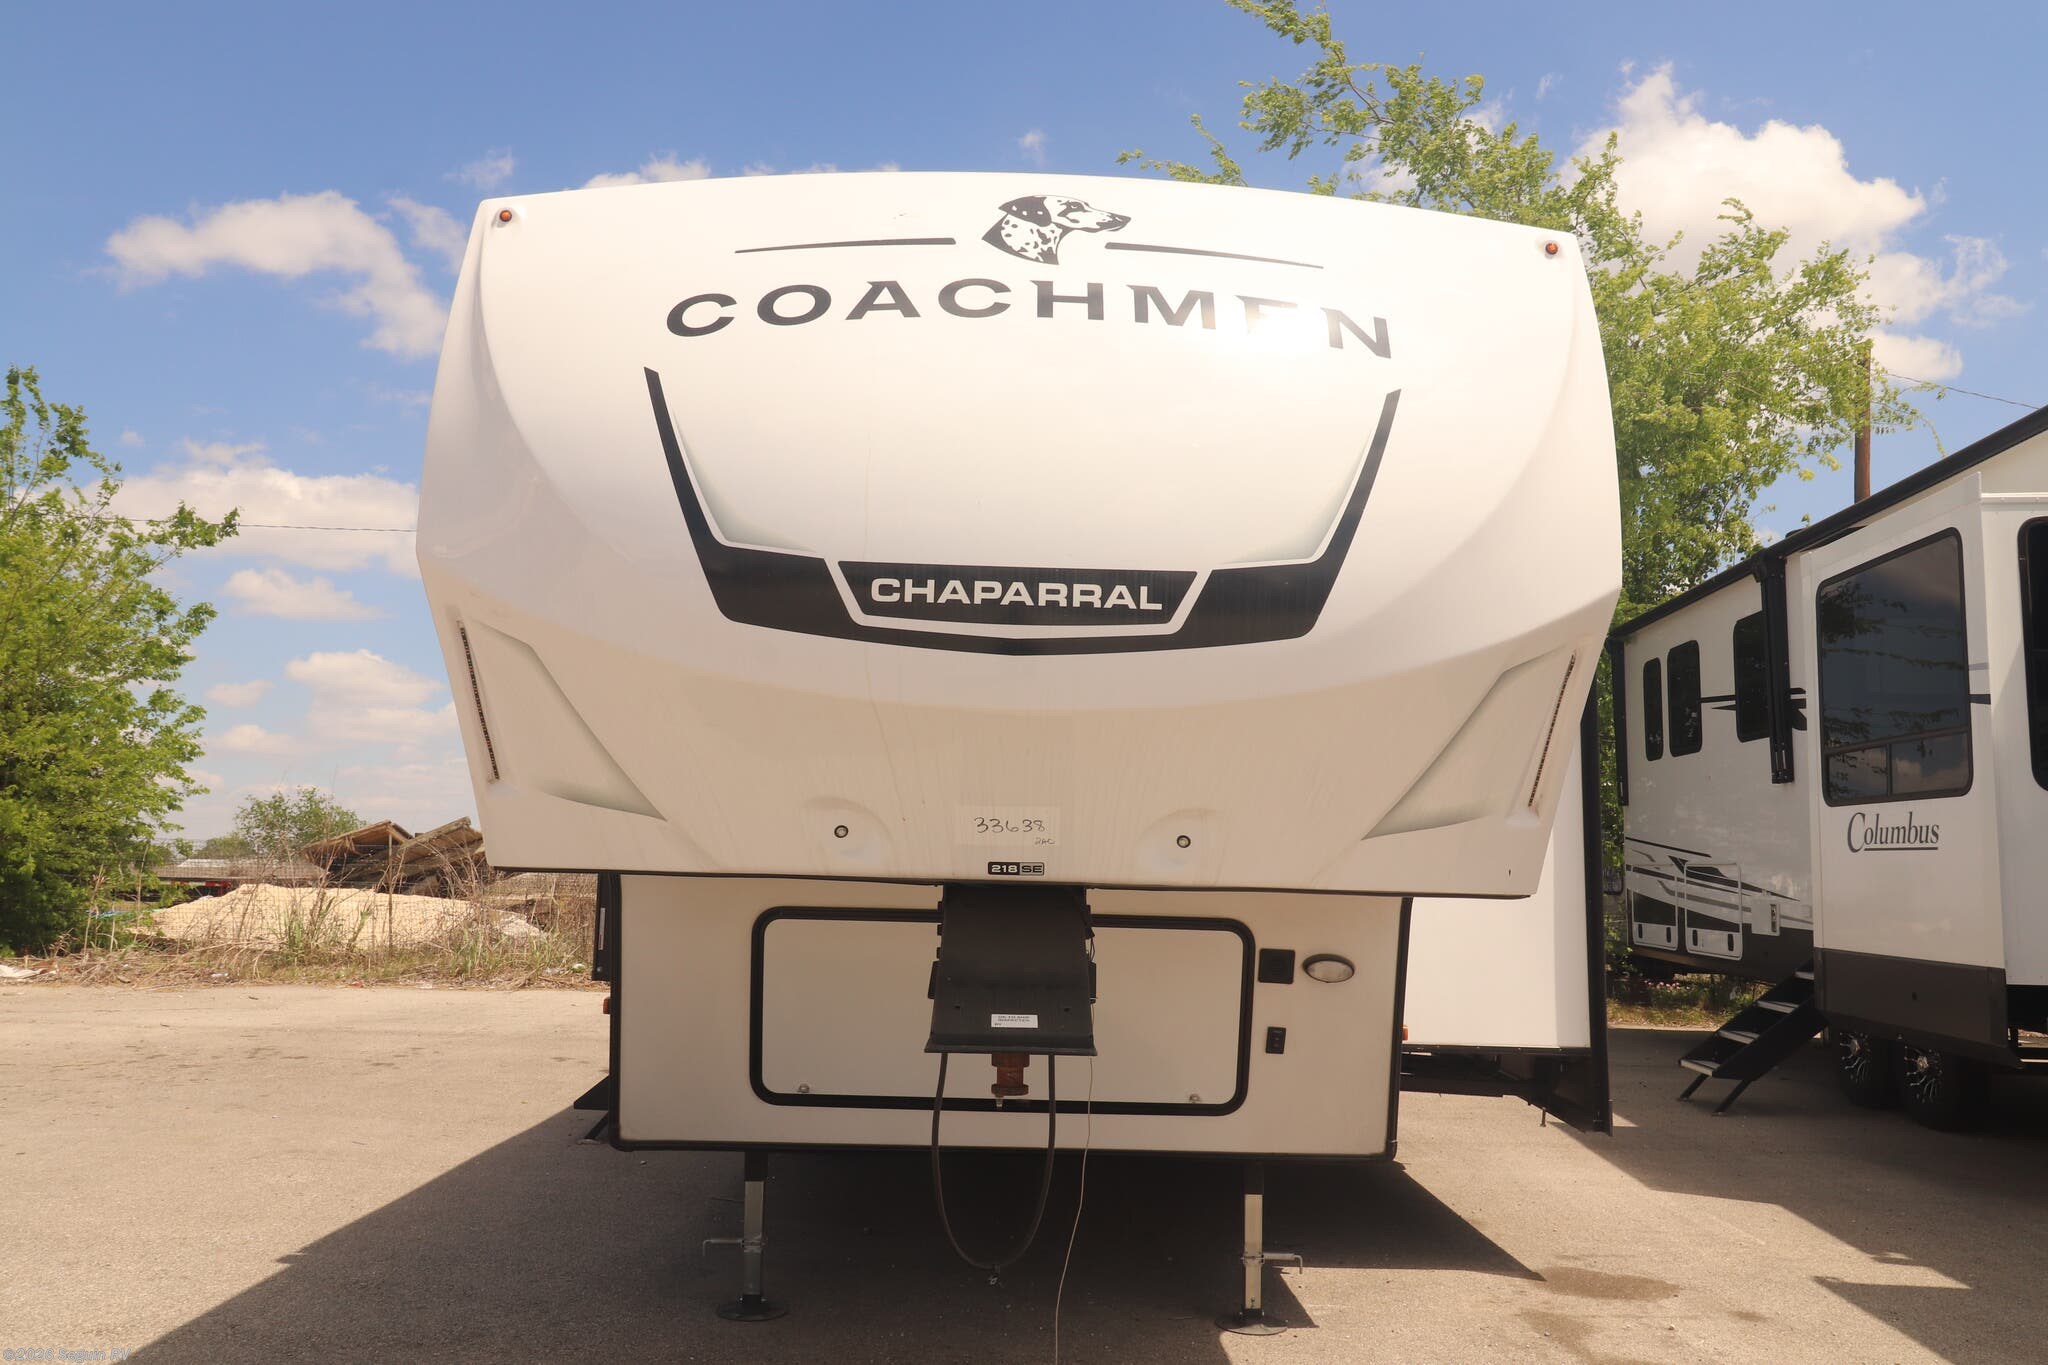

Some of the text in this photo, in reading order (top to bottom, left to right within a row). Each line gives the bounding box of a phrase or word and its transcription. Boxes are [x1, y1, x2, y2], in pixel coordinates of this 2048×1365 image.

[870, 577, 1163, 611] CHAPARRAL
[973, 816, 1045, 833] 33638
[1847, 811, 1940, 853] Columbus
